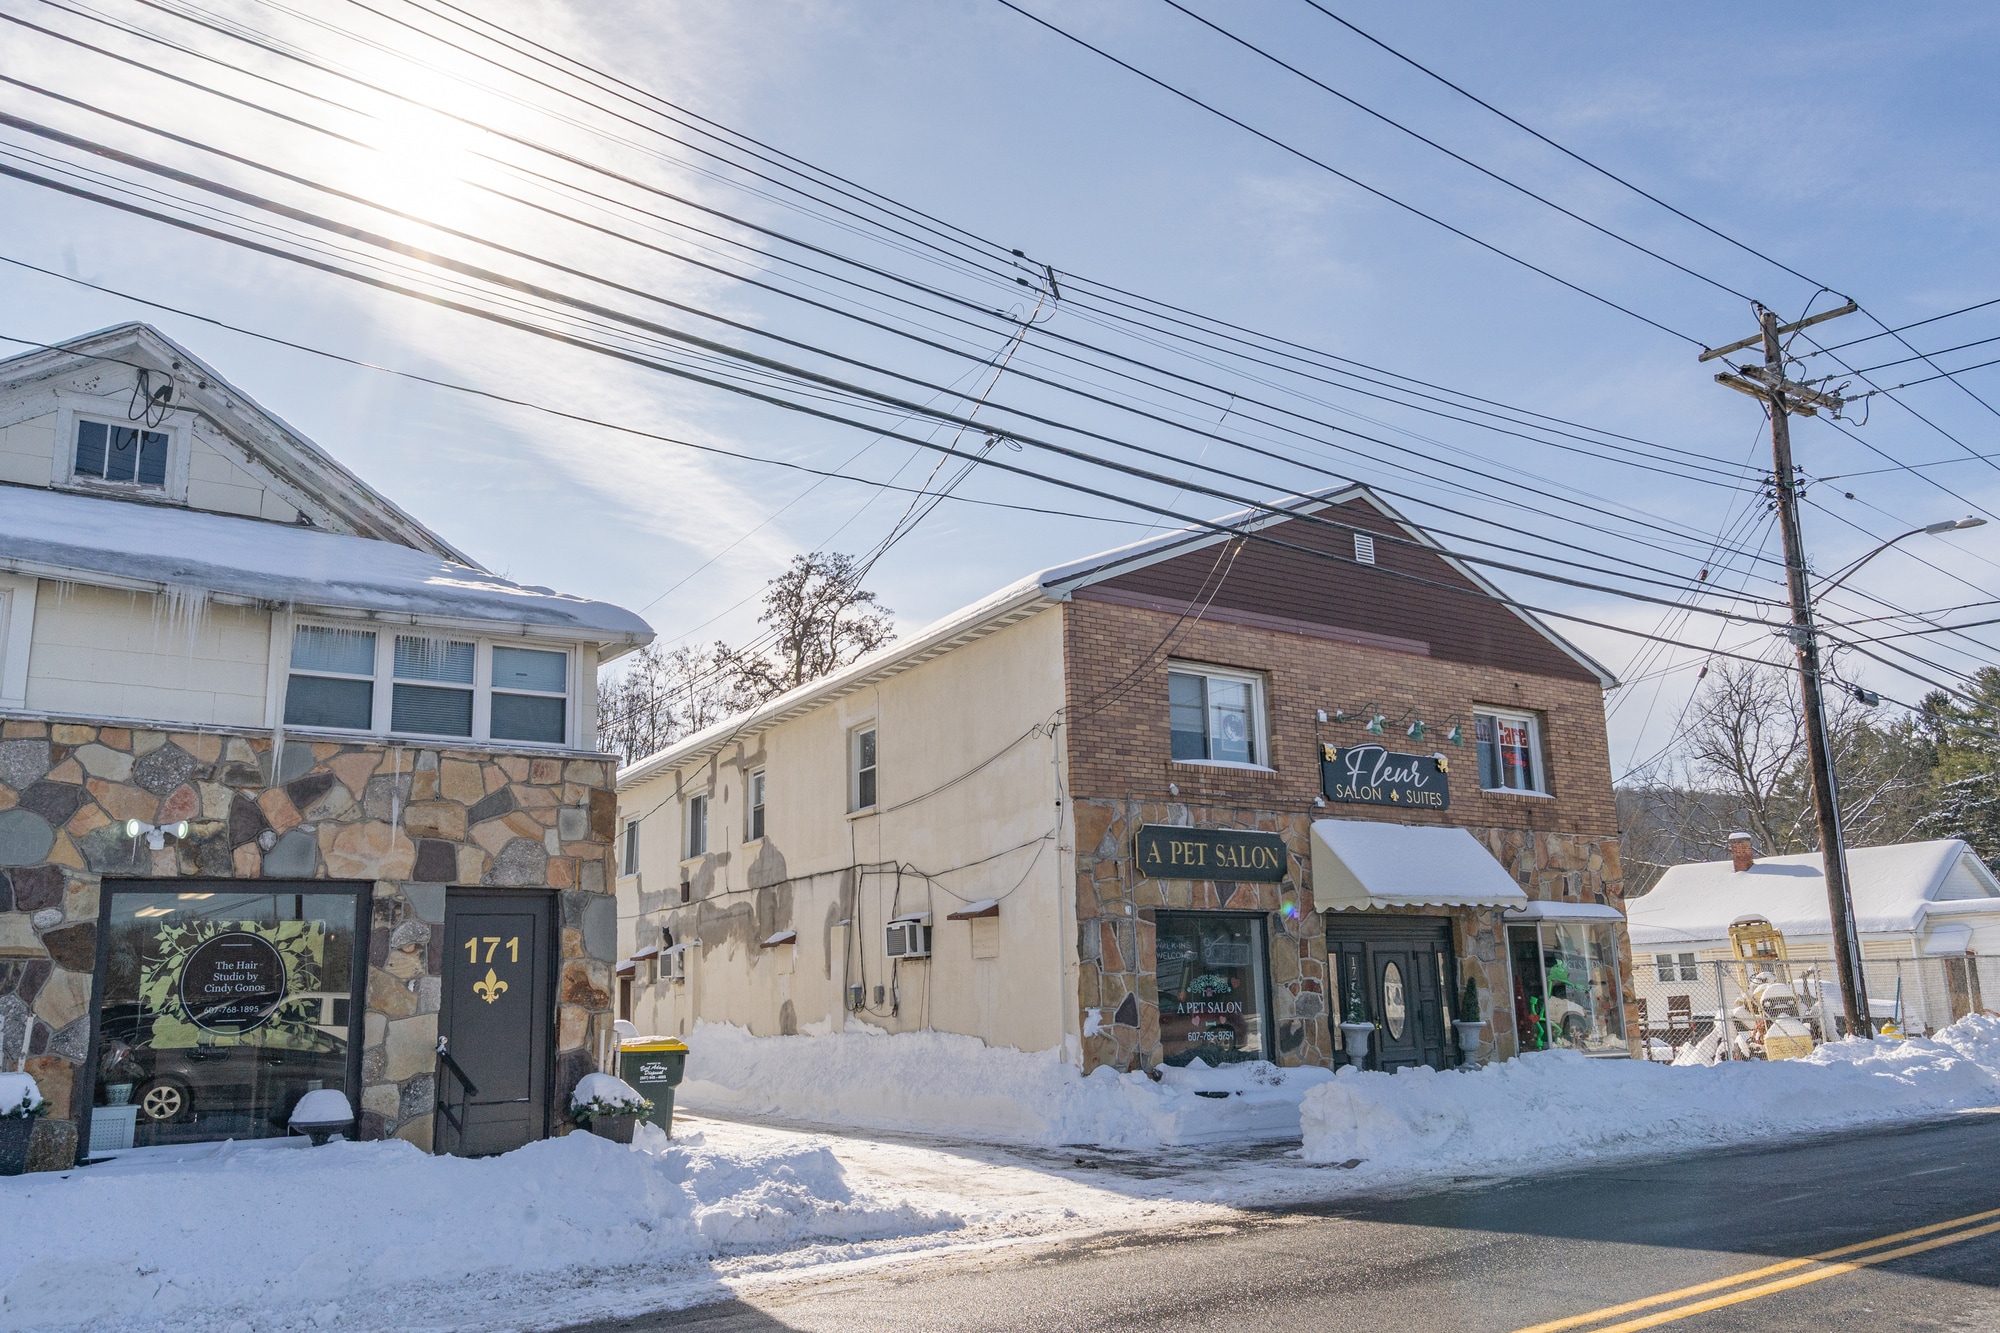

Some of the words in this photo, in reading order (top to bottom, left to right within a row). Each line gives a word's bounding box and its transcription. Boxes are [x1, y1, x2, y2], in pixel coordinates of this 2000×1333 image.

[1345, 745, 1429, 792] Fleur
[1336, 783, 1382, 800] SALON
[1406, 789, 1443, 806] SUITES
[1147, 840, 1162, 864] A
[1169, 840, 1208, 866] PET
[1215, 843, 1279, 869] SALON
[464, 936, 519, 964] 171
[1156, 951, 1191, 960] WELCOME
[215, 961, 234, 970] The
[236, 960, 258, 970] Hair
[213, 972, 245, 981] Studio
[247, 972, 259, 983] by
[204, 984, 234, 994] Cindy
[235, 983, 266, 992] Gonos
[203, 1005, 259, 1014] 607-768-1895
[1177, 1002, 1185, 1014] A
[1186, 1002, 1206, 1014] PET
[1207, 1001, 1243, 1013] SALON
